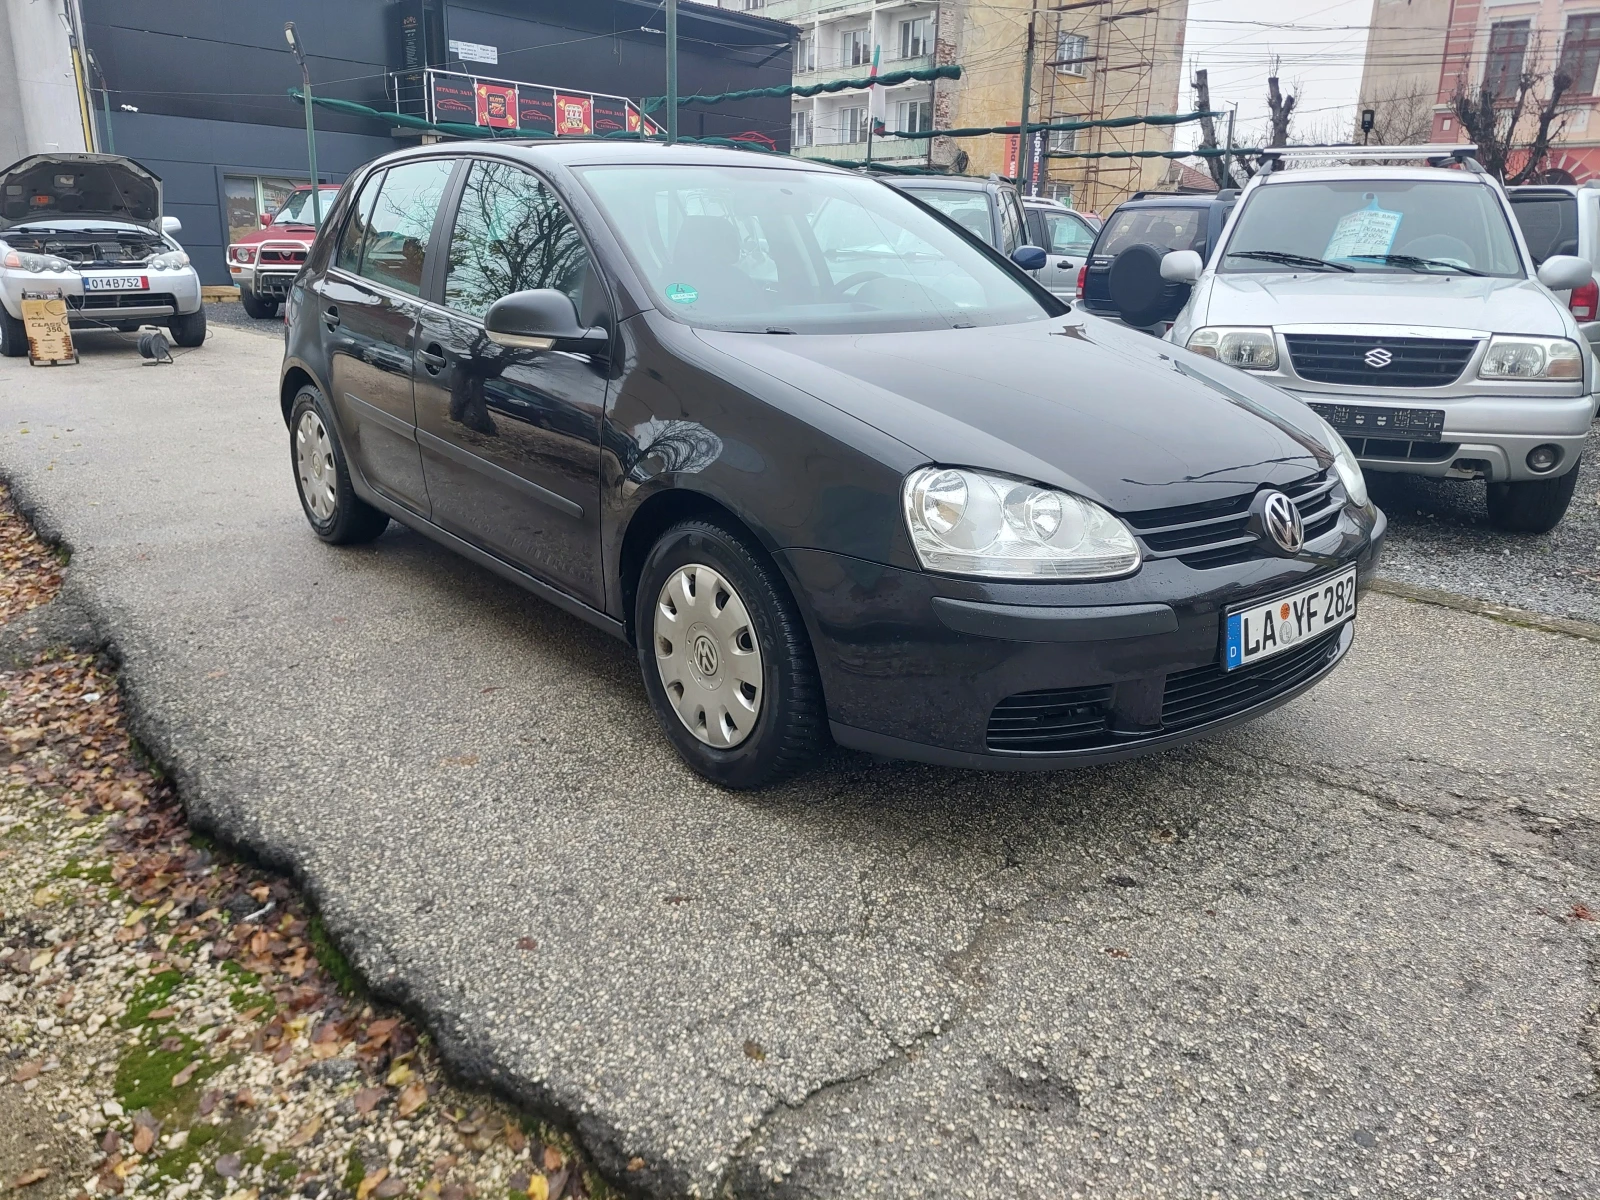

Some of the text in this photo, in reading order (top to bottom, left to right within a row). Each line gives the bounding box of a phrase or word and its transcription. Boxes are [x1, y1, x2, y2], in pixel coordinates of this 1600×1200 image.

[566, 109, 582, 118] 777
[91, 278, 140, 289] 014B752
[675, 283, 686, 294] 4
[1243, 576, 1354, 657] LA YF 282
[1230, 646, 1237, 658] D
